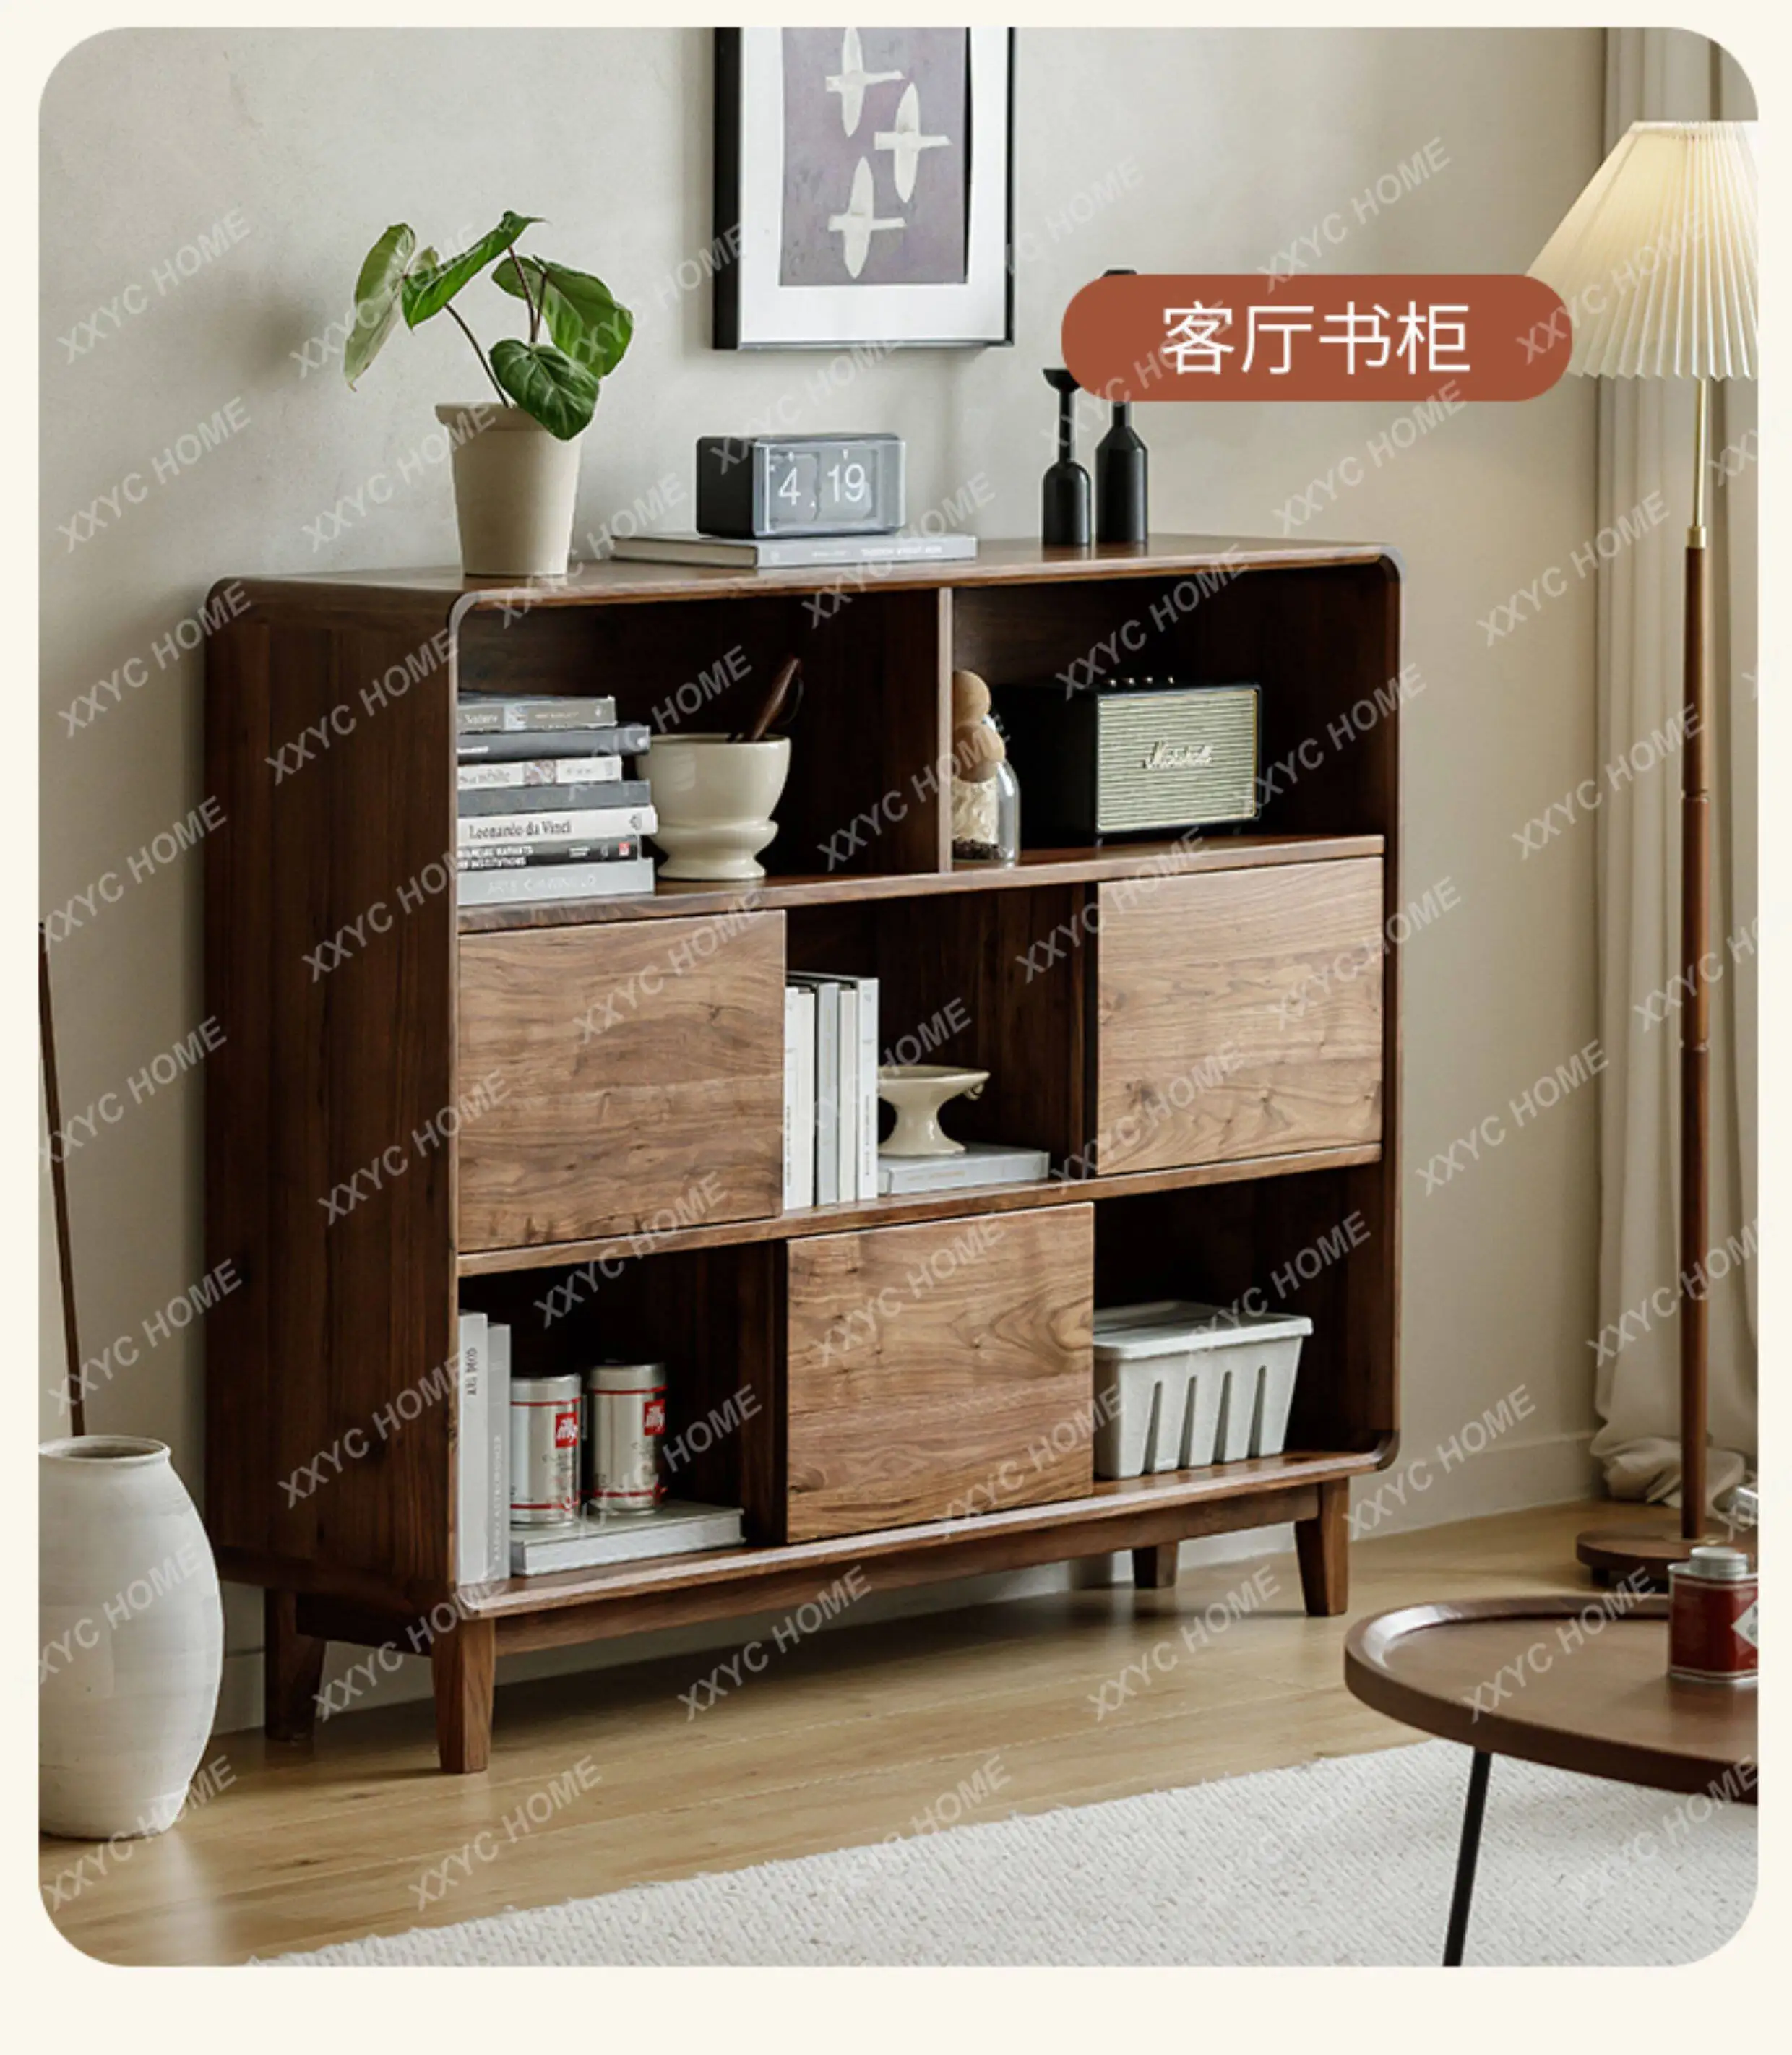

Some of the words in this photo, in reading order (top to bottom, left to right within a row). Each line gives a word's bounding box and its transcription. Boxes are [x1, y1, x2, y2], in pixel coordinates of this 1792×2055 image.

[778, 467, 802, 506] 4
[827, 463, 866, 502] 19
[468, 822, 523, 839] Leonardo
[526, 821, 540, 836] da
[541, 819, 572, 834] Vinci
